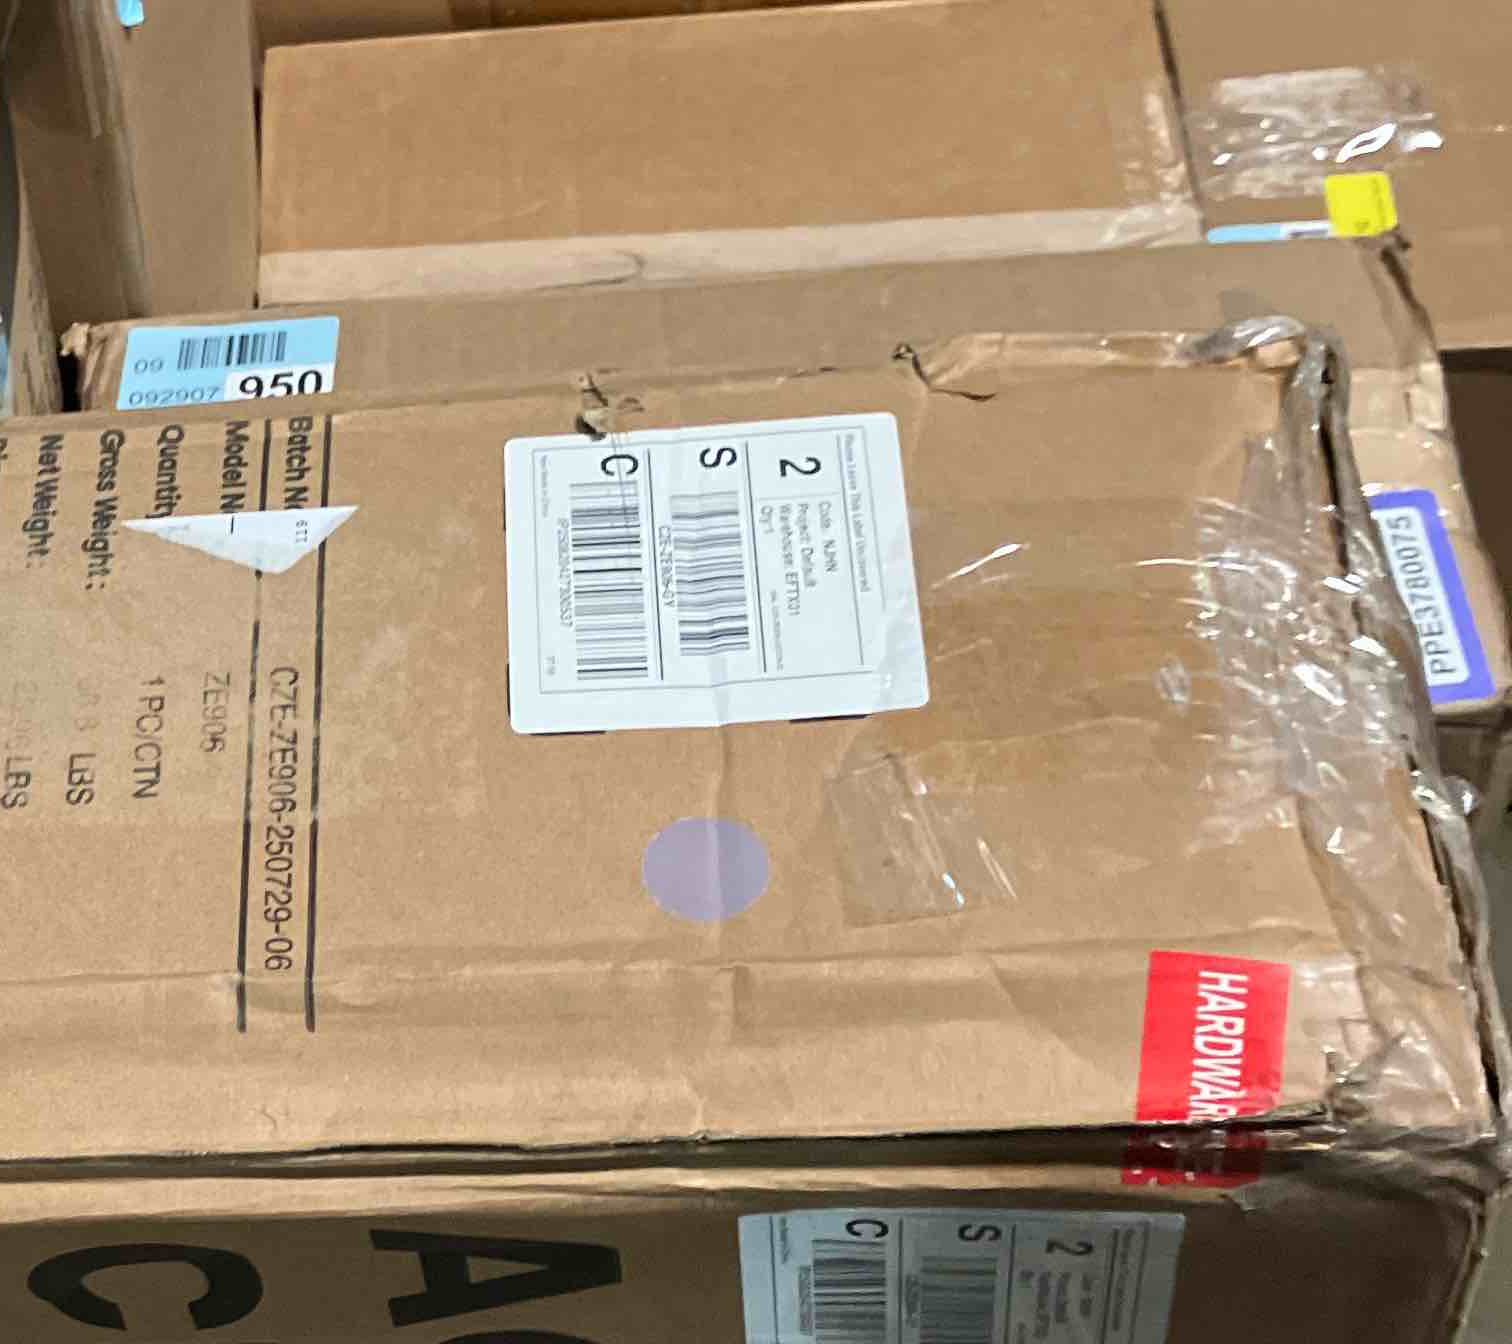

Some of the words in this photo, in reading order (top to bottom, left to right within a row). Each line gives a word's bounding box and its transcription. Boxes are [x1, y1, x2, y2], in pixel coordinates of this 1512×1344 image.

[132, 355, 166, 376] 09
[237, 368, 325, 400] 950
[37, 432, 65, 475] Net
[93, 427, 127, 491] Gross
[218, 419, 252, 488] Model
[287, 415, 314, 485] Batch
[599, 452, 640, 478] C
[698, 446, 739, 470] S
[778, 455, 822, 478] 2
[81, 492, 116, 591] Weight:
[1387, 513, 1456, 676] PPE3780075
[199, 670, 232, 754] ZE906
[132, 692, 166, 802] PC/CTN
[0, 755, 32, 811] LBS
[65, 751, 96, 807] LBS
[263, 666, 300, 972] CZE-ZE906-250729-06
[1186, 969, 1249, 1123] HARDWAR
[844, 1217, 889, 1240] C
[957, 1222, 1003, 1244] S
[1043, 1240, 1095, 1258] 2
